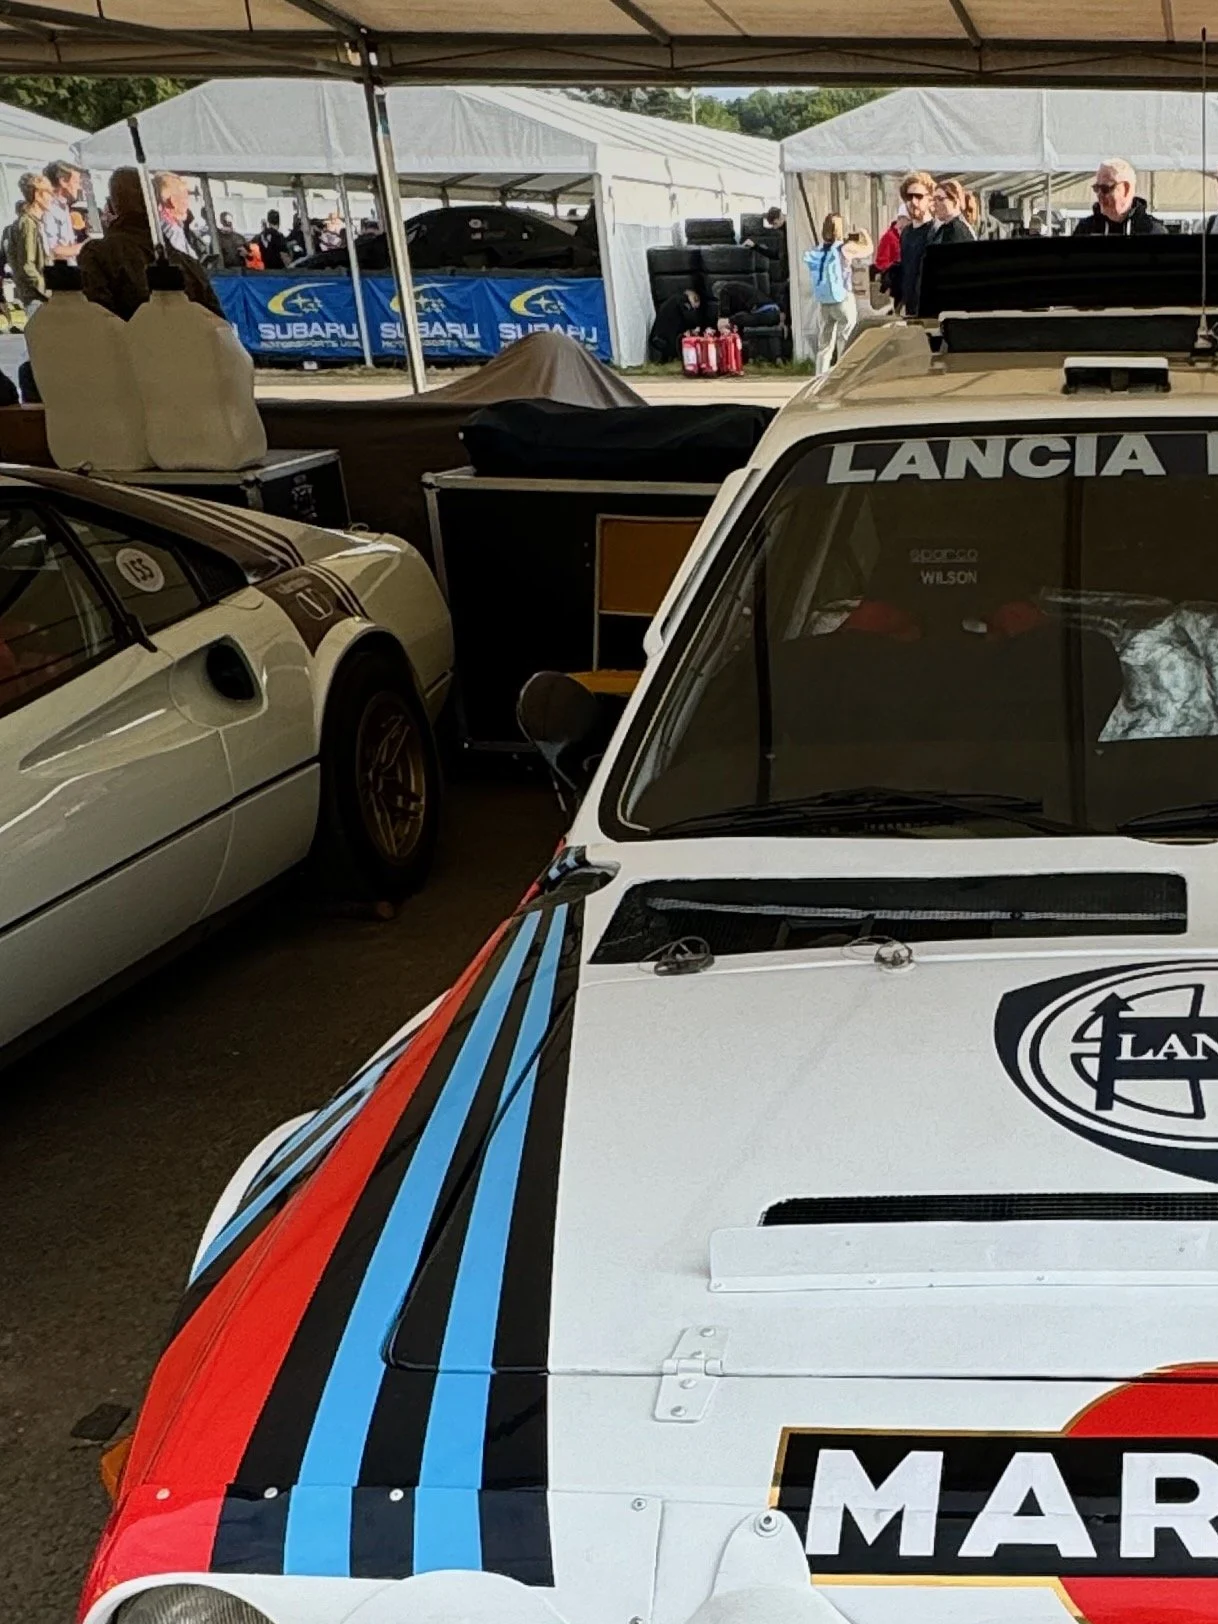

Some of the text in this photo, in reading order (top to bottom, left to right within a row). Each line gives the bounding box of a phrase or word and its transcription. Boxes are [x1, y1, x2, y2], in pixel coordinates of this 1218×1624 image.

[258, 322, 359, 340] SUBARU
[825, 434, 1167, 484] LANCIA
[122, 558, 154, 583] 155
[920, 569, 978, 585] WILSON
